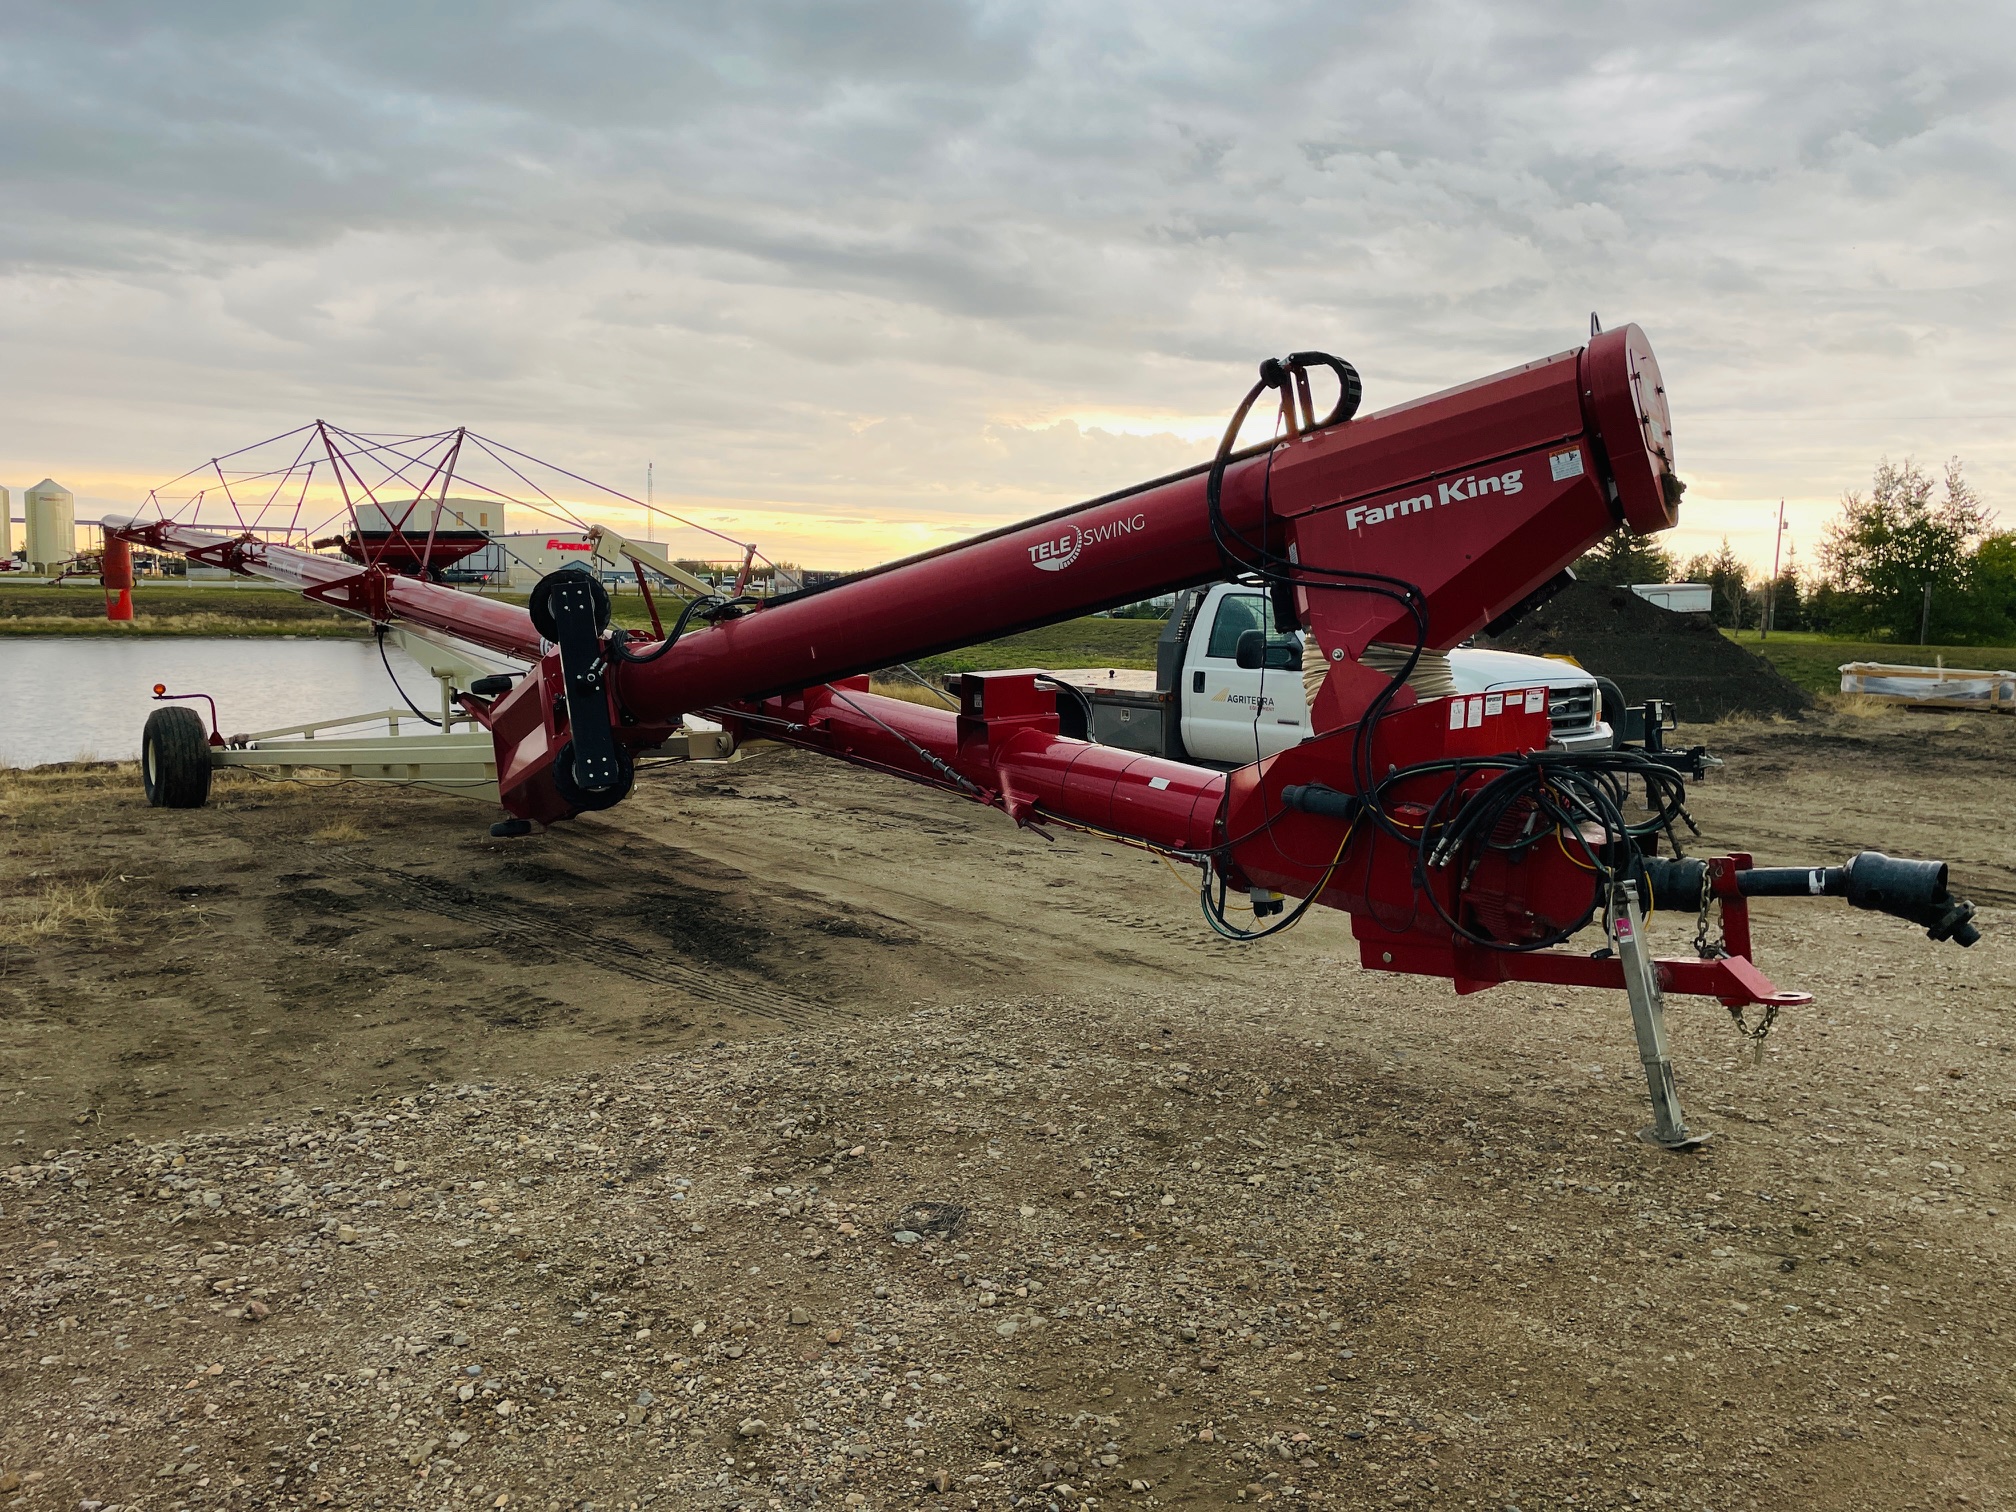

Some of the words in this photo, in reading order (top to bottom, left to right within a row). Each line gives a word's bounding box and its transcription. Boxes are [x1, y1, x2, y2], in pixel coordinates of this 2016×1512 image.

[1346, 493, 1433, 530] Farm
[1438, 469, 1523, 506] King
[1028, 535, 1071, 561] TELE
[1083, 513, 1146, 546] SWING
